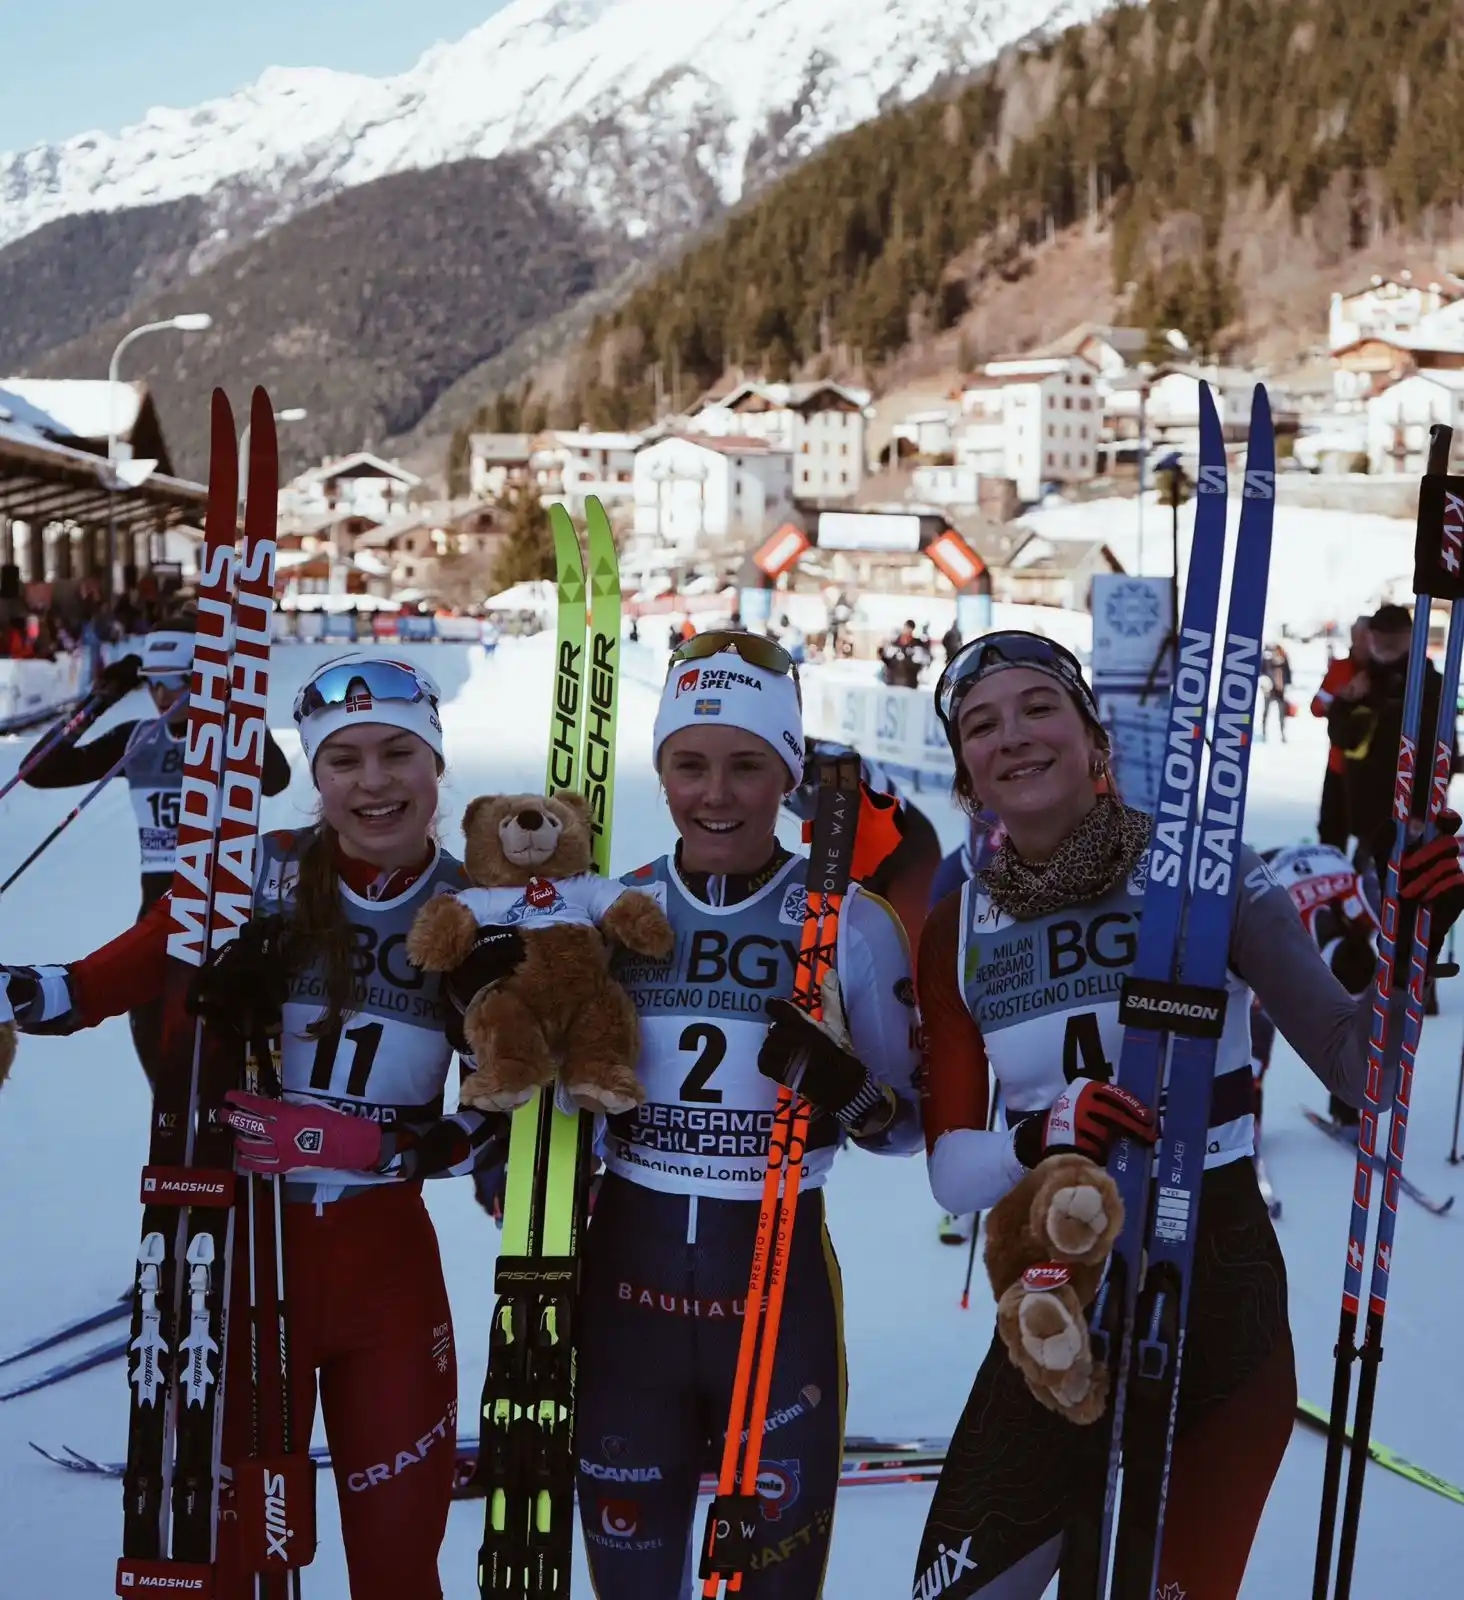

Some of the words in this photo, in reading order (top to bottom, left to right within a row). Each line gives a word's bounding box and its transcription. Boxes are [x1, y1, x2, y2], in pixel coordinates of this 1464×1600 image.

[700, 680, 732, 690] SPEL
[702, 670, 762, 691] SVENSKA
[549, 640, 581, 796] CHER
[166, 541, 234, 968] MADSHUS
[211, 536, 277, 951] MADSHUS
[1150, 628, 1211, 888] SALOMON
[1198, 633, 1259, 896] SALOMON
[1394, 734, 1415, 820] KV+
[147, 792, 181, 829] 15
[830, 792, 846, 835] WAY
[823, 848, 839, 890] ONE
[347, 924, 425, 989] BG
[993, 936, 1033, 960] MILAN
[1047, 911, 1142, 979] BG
[976, 952, 1034, 984] BERGAMO
[986, 969, 1035, 997] AIRPORT
[631, 988, 703, 1009] OSTEGNO
[708, 990, 761, 1013] DELLO
[989, 981, 1070, 1022] SOSTEGNO
[1074, 972, 1126, 998] DELLO
[1126, 995, 1219, 1021] SALOMON
[306, 1022, 384, 1097] 11
[678, 1023, 728, 1103] 2
[1063, 1012, 1114, 1085] 4
[228, 1113, 266, 1134] HESTRA
[637, 1104, 775, 1133] BERGAMO
[630, 1124, 771, 1155] SCHILPARI
[160, 1180, 225, 1193] MADSHUS
[771, 1232, 786, 1286] PREMIO
[780, 1208, 789, 1225] 40
[497, 1271, 573, 1280] FISCHER
[432, 1322, 448, 1338] NOR
[348, 1416, 447, 1492] CRAFT
[580, 1458, 664, 1482] SCANIA
[636, 1538, 664, 1551] SPEL
[741, 1521, 756, 1540] W
[139, 1576, 203, 1589] MADSHUS
